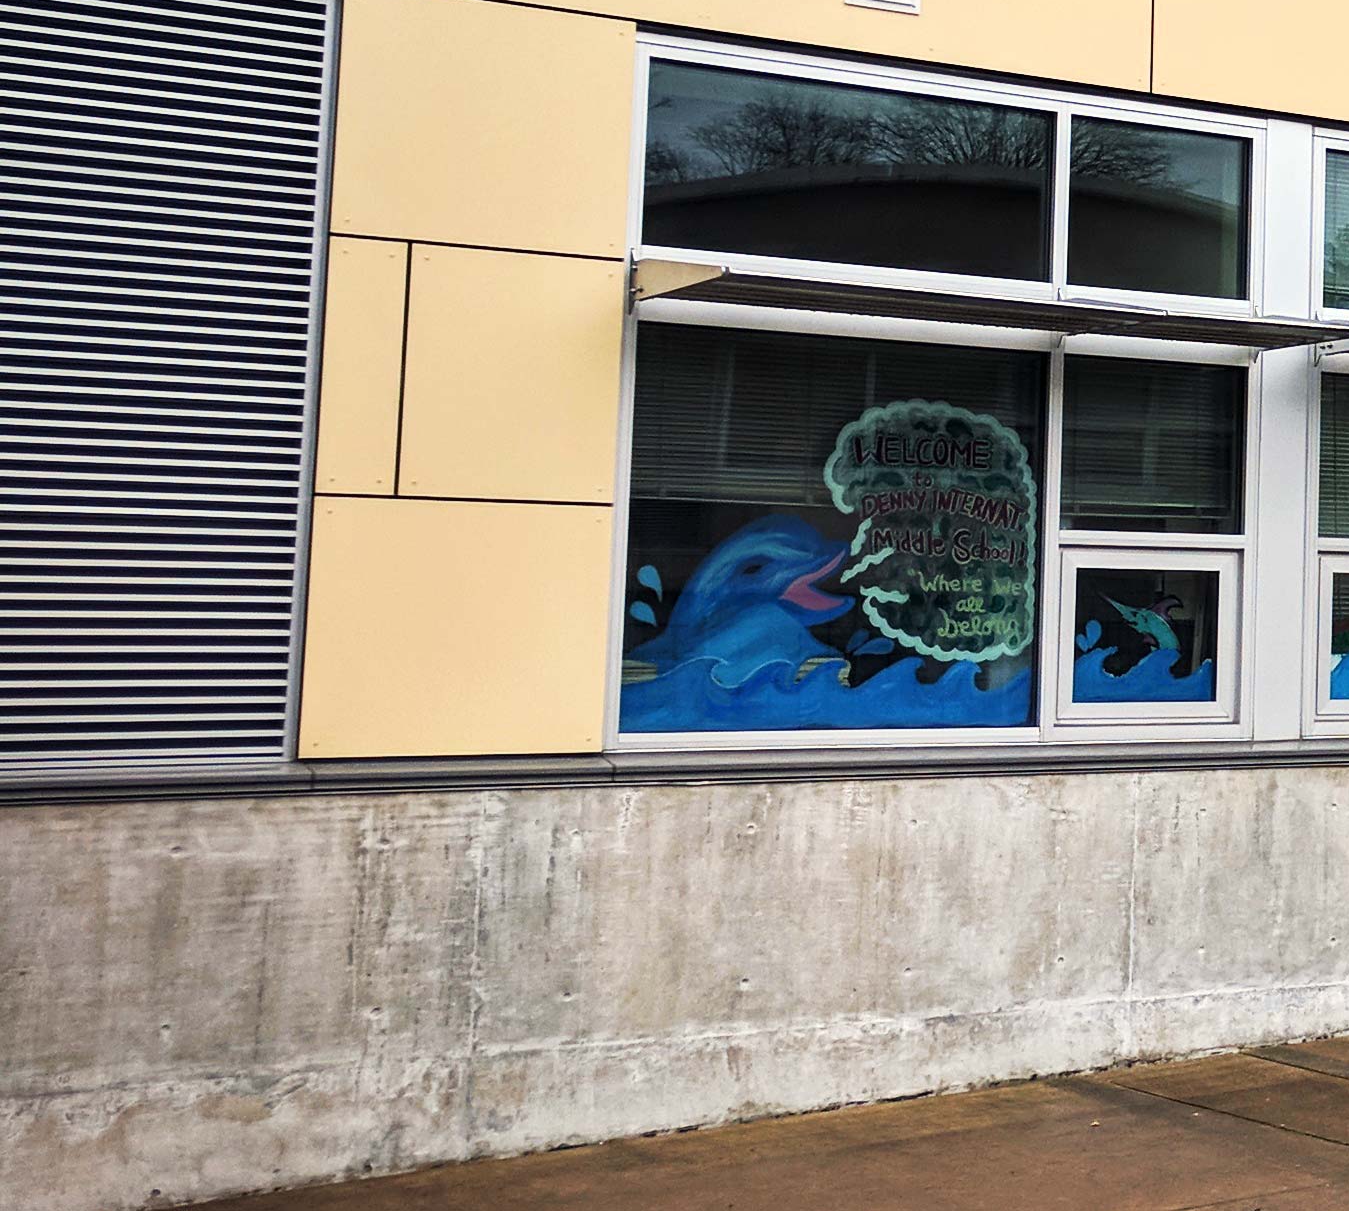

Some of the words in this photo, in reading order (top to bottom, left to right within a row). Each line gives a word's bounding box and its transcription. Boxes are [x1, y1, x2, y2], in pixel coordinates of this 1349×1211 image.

[853, 434, 994, 470] WELCOME
[912, 471, 933, 487] to
[860, 490, 927, 519] DENNY
[931, 487, 1025, 532] INTERNAT.
[871, 528, 946, 556] Middle
[952, 529, 1028, 567] School!
[955, 595, 986, 614] all
[937, 608, 1021, 650] belong
